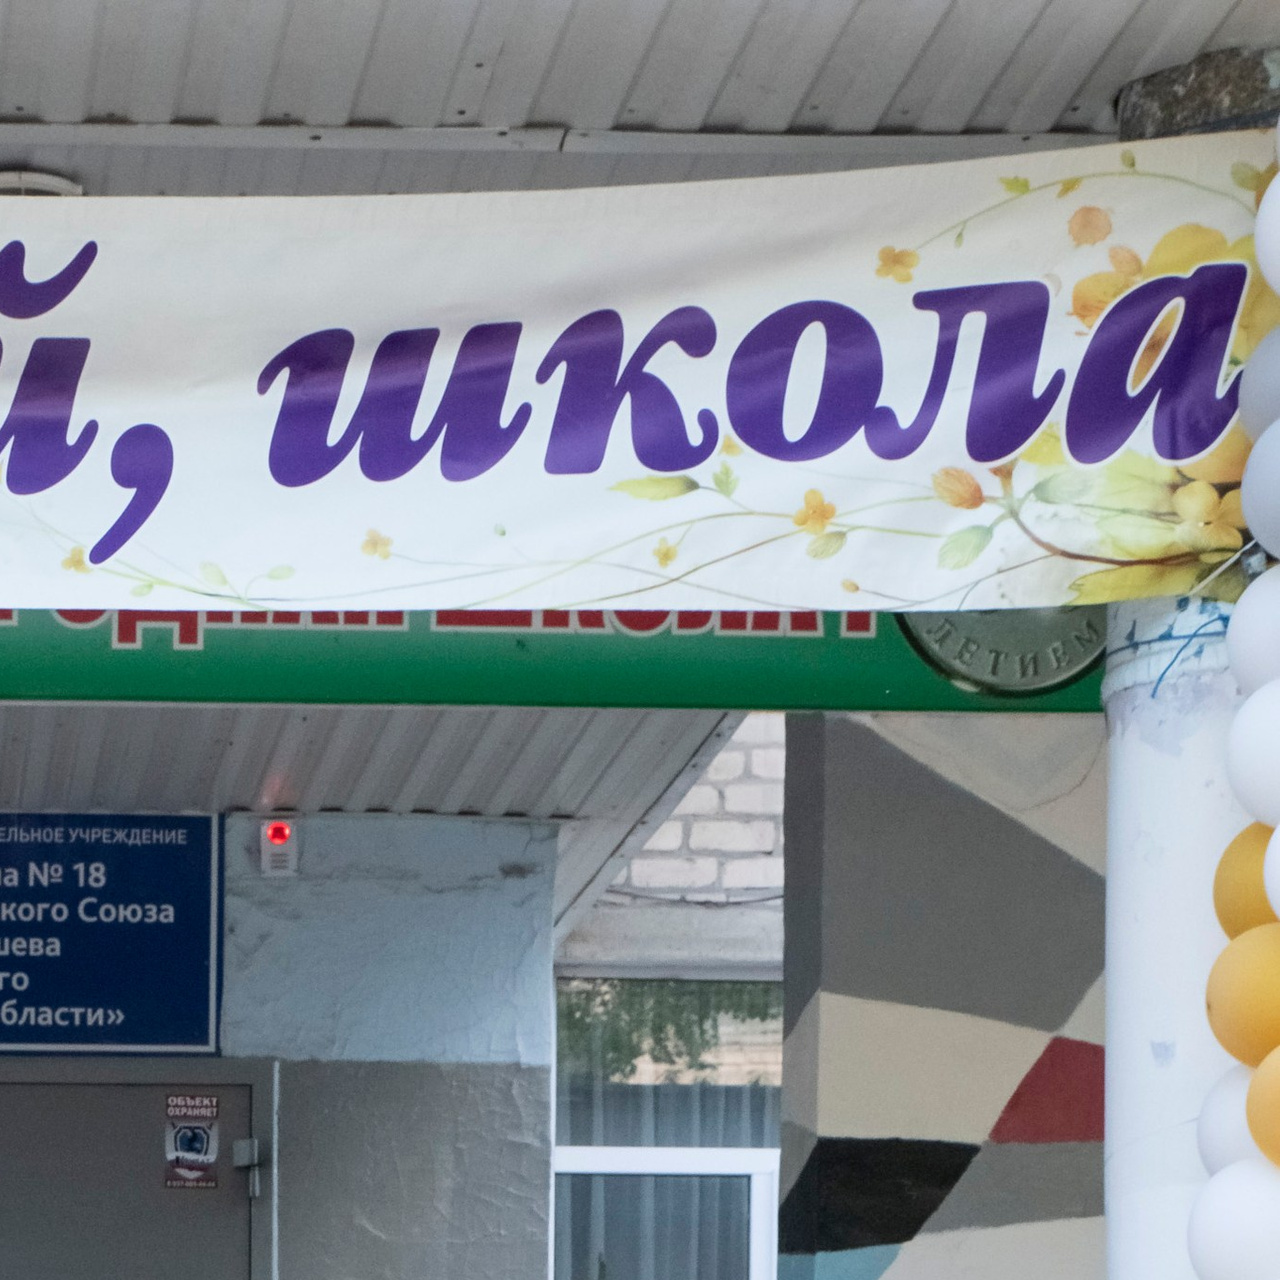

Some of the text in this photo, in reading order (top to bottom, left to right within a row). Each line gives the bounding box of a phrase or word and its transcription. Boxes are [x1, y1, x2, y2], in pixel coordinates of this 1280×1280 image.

[257, 263, 1248, 488] школа
[69, 828, 188, 846] УЧРЕЖДЕНИЕ
[28, 861, 63, 888] №
[72, 862, 107, 888] 18
[77, 896, 176, 923] Союза
[167, 1096, 218, 1107] ОБЪЕКТ
[167, 1107, 218, 1117] ОХРАНЯЕТ
